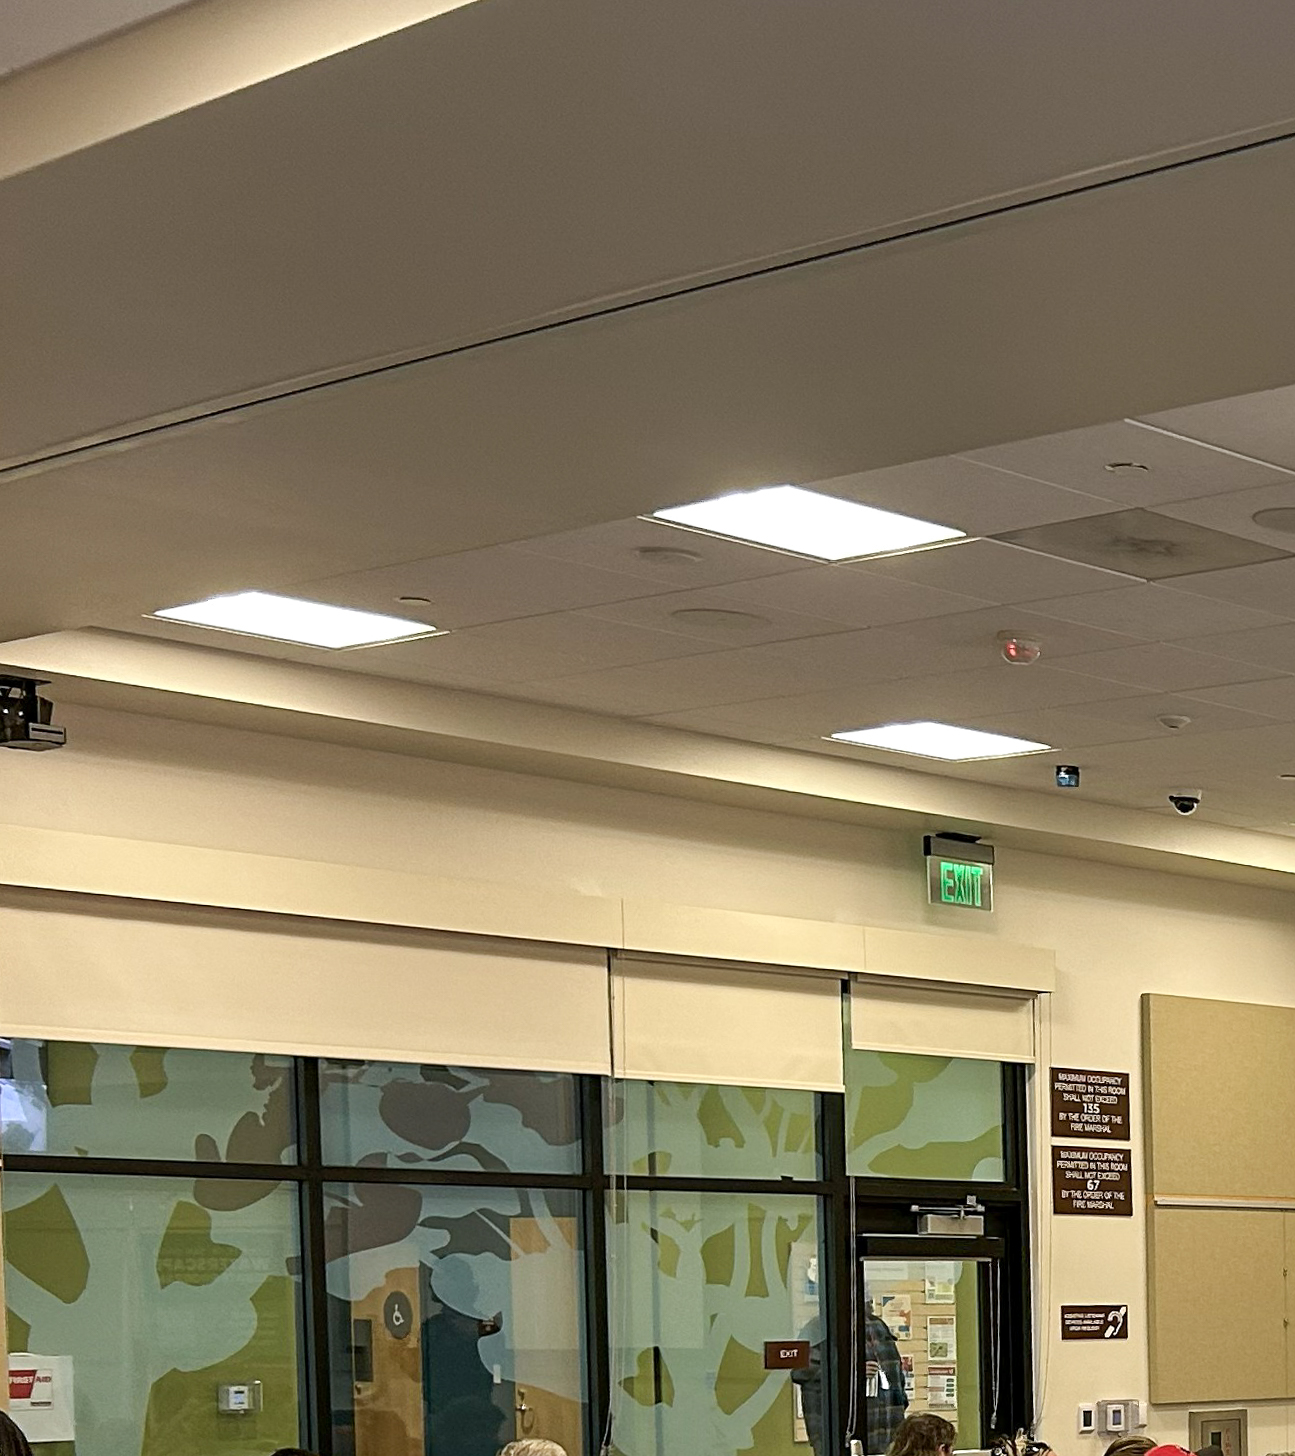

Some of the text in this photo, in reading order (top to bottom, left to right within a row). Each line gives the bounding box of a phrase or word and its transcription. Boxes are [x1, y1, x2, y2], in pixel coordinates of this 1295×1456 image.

[941, 862, 983, 907] EXIT
[1082, 1103, 1100, 1114] 135
[1086, 1179, 1100, 1191] 67
[779, 1349, 799, 1358] EXIT
